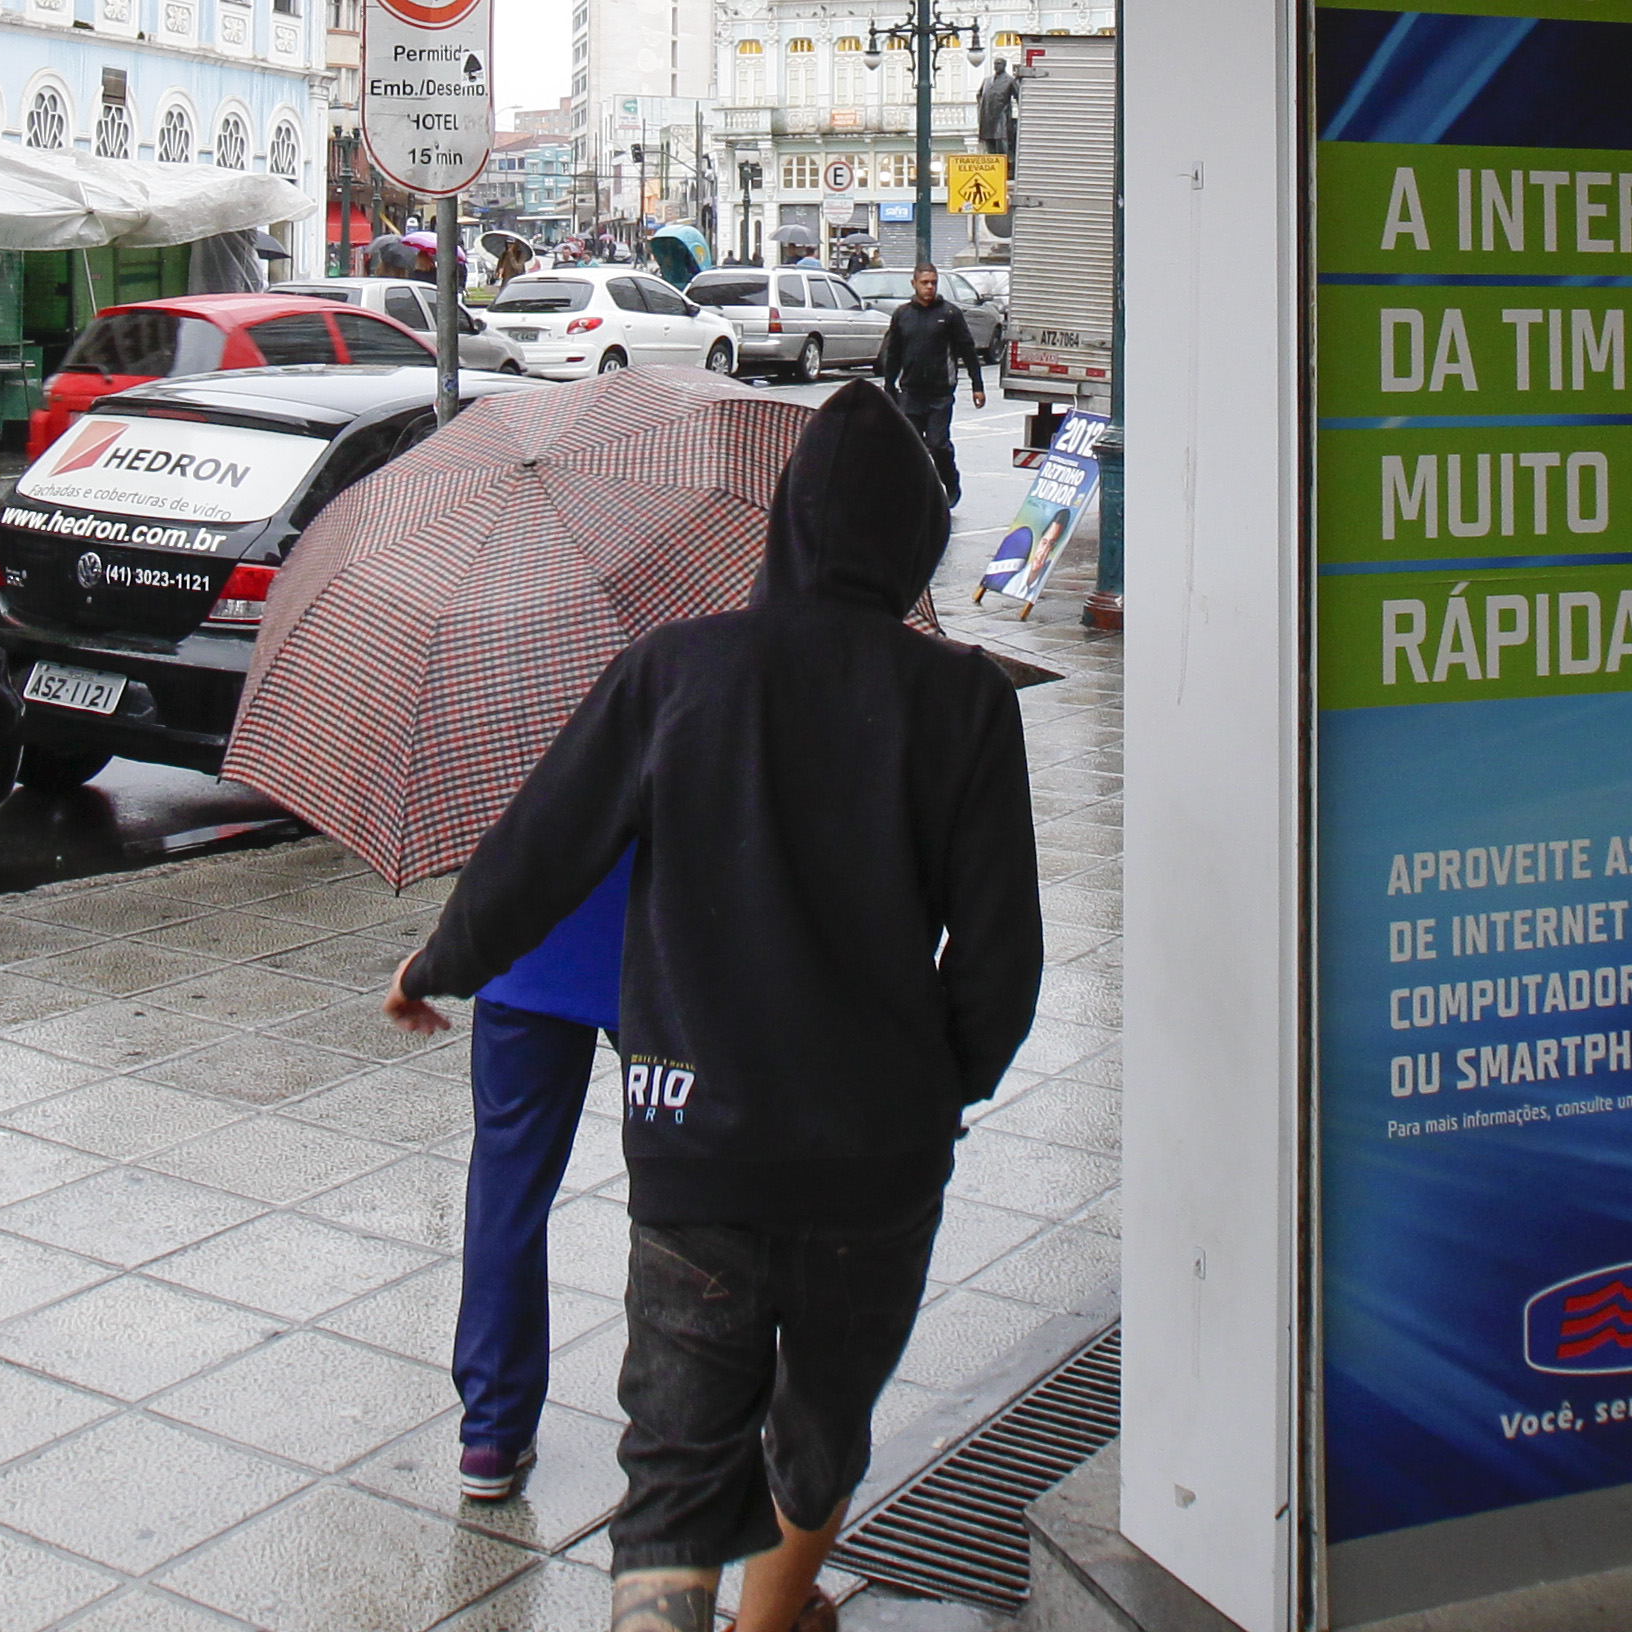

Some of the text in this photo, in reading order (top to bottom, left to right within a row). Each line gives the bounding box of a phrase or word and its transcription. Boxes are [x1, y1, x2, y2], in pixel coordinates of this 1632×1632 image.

[393, 45, 471, 62] Permitid
[408, 148, 464, 166] 15 min
[833, 167, 844, 186] E
[954, 157, 1000, 165] TRAVESSIA
[957, 164, 996, 172] ELEVADA
[1380, 167, 1431, 251] A
[1040, 329, 1080, 348] ATZ-7064
[1380, 307, 1479, 393] DA
[1502, 308, 1626, 392] TIM
[102, 446, 251, 489] HEDRON
[28, 484, 233, 522] Fachadas e coberturas de vidro
[1381, 451, 1610, 541] MUITO
[0, 505, 227, 553] www.hedron.com.br
[105, 564, 211, 592] (41) 3023-1121
[1387, 838, 1592, 897] APROVEITE
[1389, 918, 1437, 964] DE
[1452, 899, 1630, 957] INTERNET
[628, 1064, 695, 1107] RIO
[1390, 1049, 1442, 1098] OU
[1387, 1118, 1421, 1139] Para
[1425, 1113, 1458, 1134] mais
[1462, 1103, 1552, 1130] informações,
[1555, 1094, 1614, 1117] consulte
[1499, 1400, 1585, 1440] Você,
